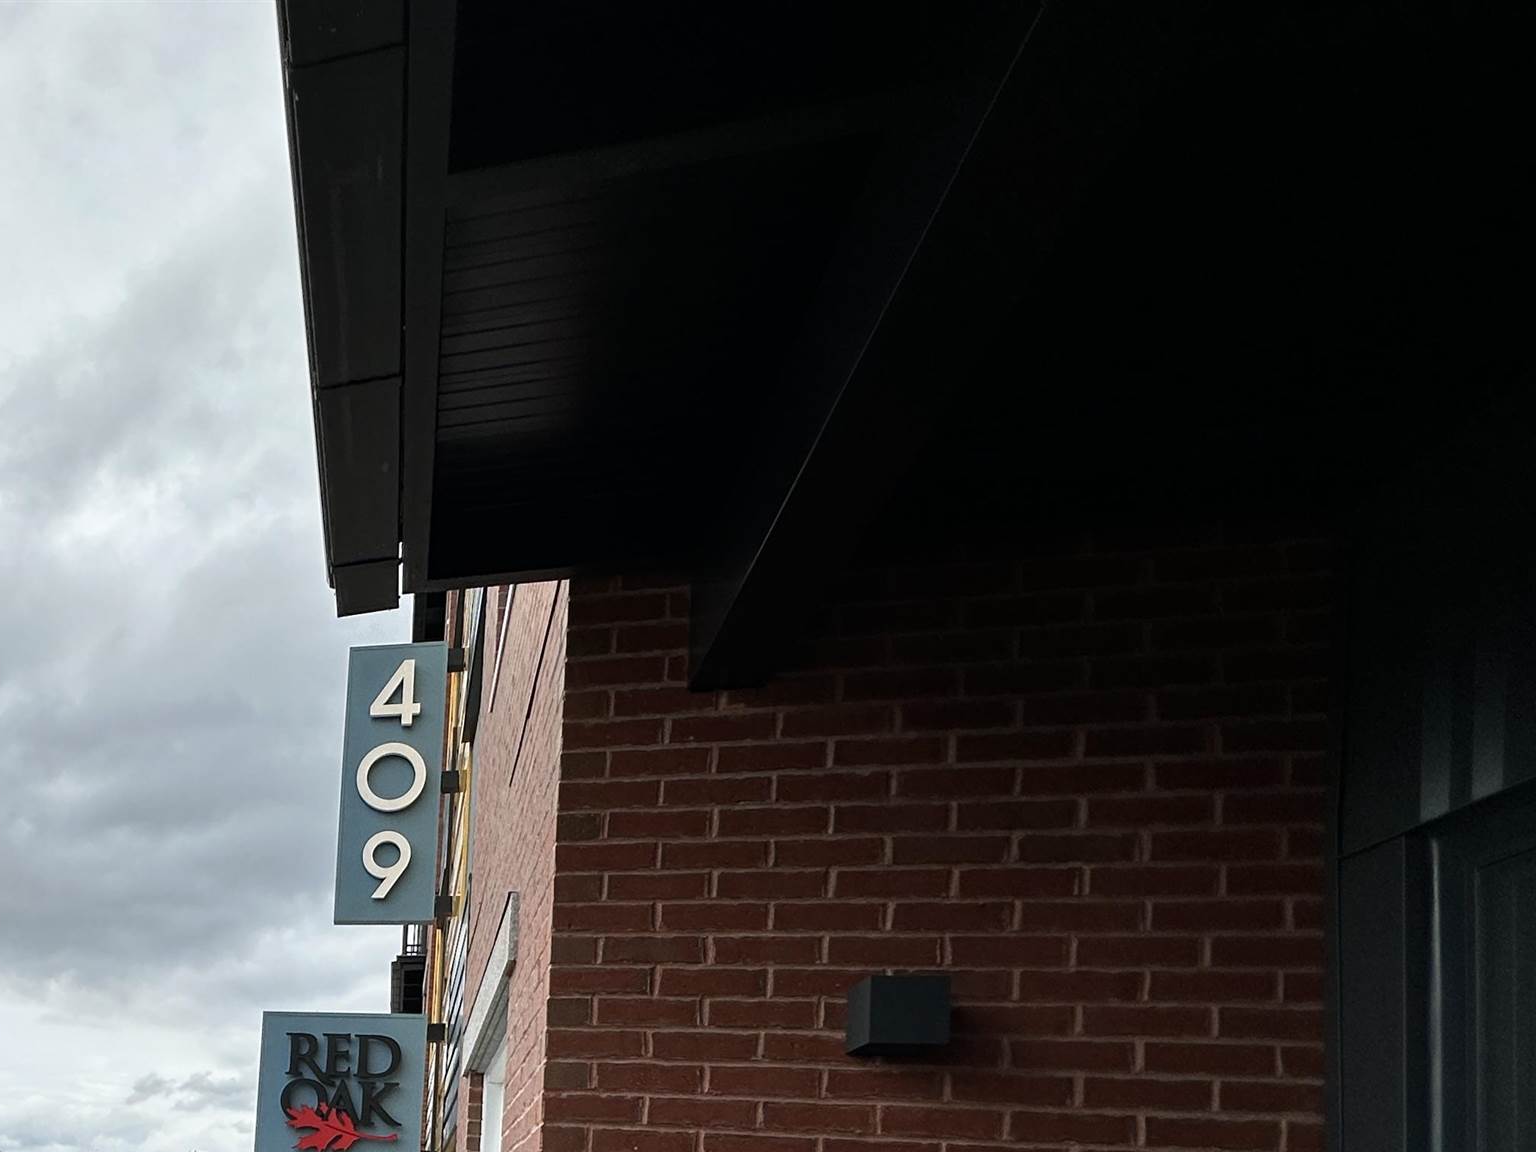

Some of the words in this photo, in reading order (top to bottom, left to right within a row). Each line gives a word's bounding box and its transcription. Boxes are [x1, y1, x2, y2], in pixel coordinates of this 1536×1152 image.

[356, 659, 427, 899] 409
[284, 1032, 403, 1086] RED
[280, 1078, 403, 1129] OAK
